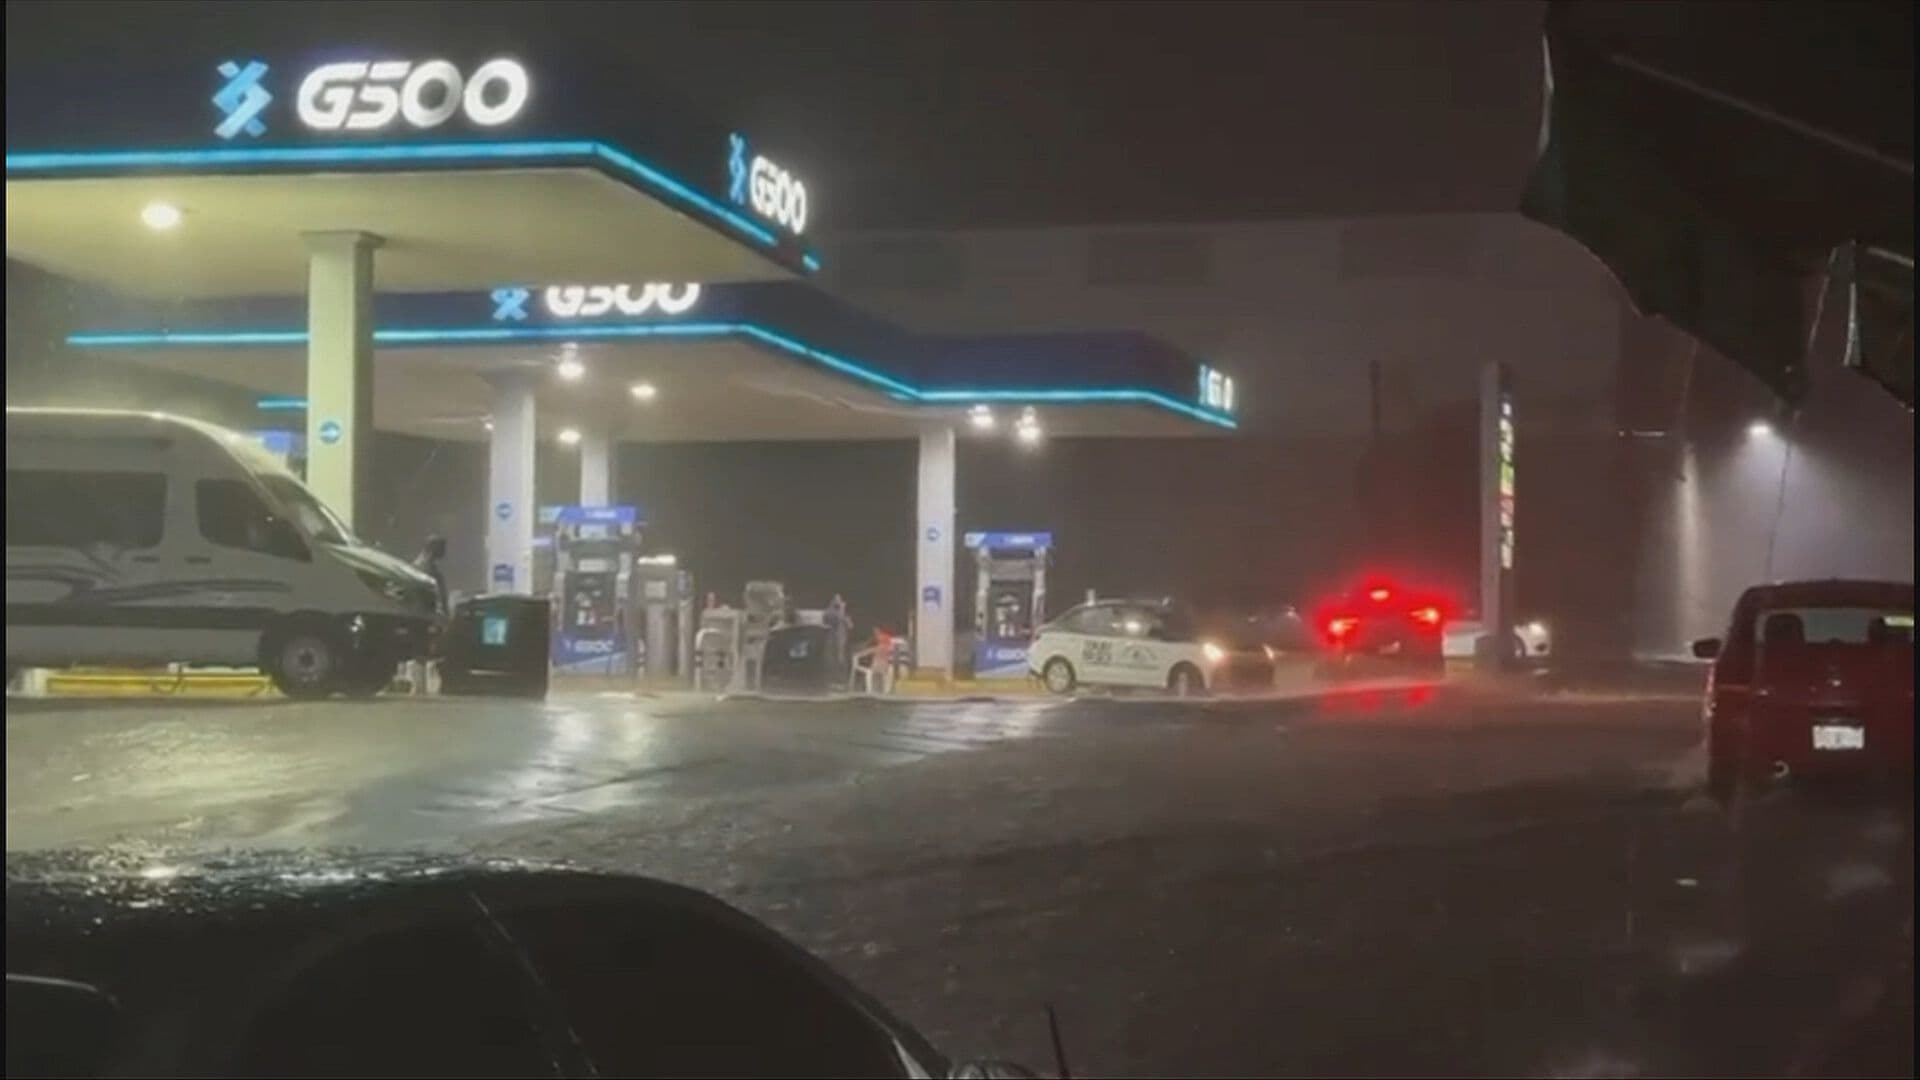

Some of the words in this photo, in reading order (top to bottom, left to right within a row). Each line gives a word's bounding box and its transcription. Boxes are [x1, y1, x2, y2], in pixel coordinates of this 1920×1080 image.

[297, 58, 529, 129] G500
[749, 154, 807, 234] G500
[545, 283, 700, 317] G500
